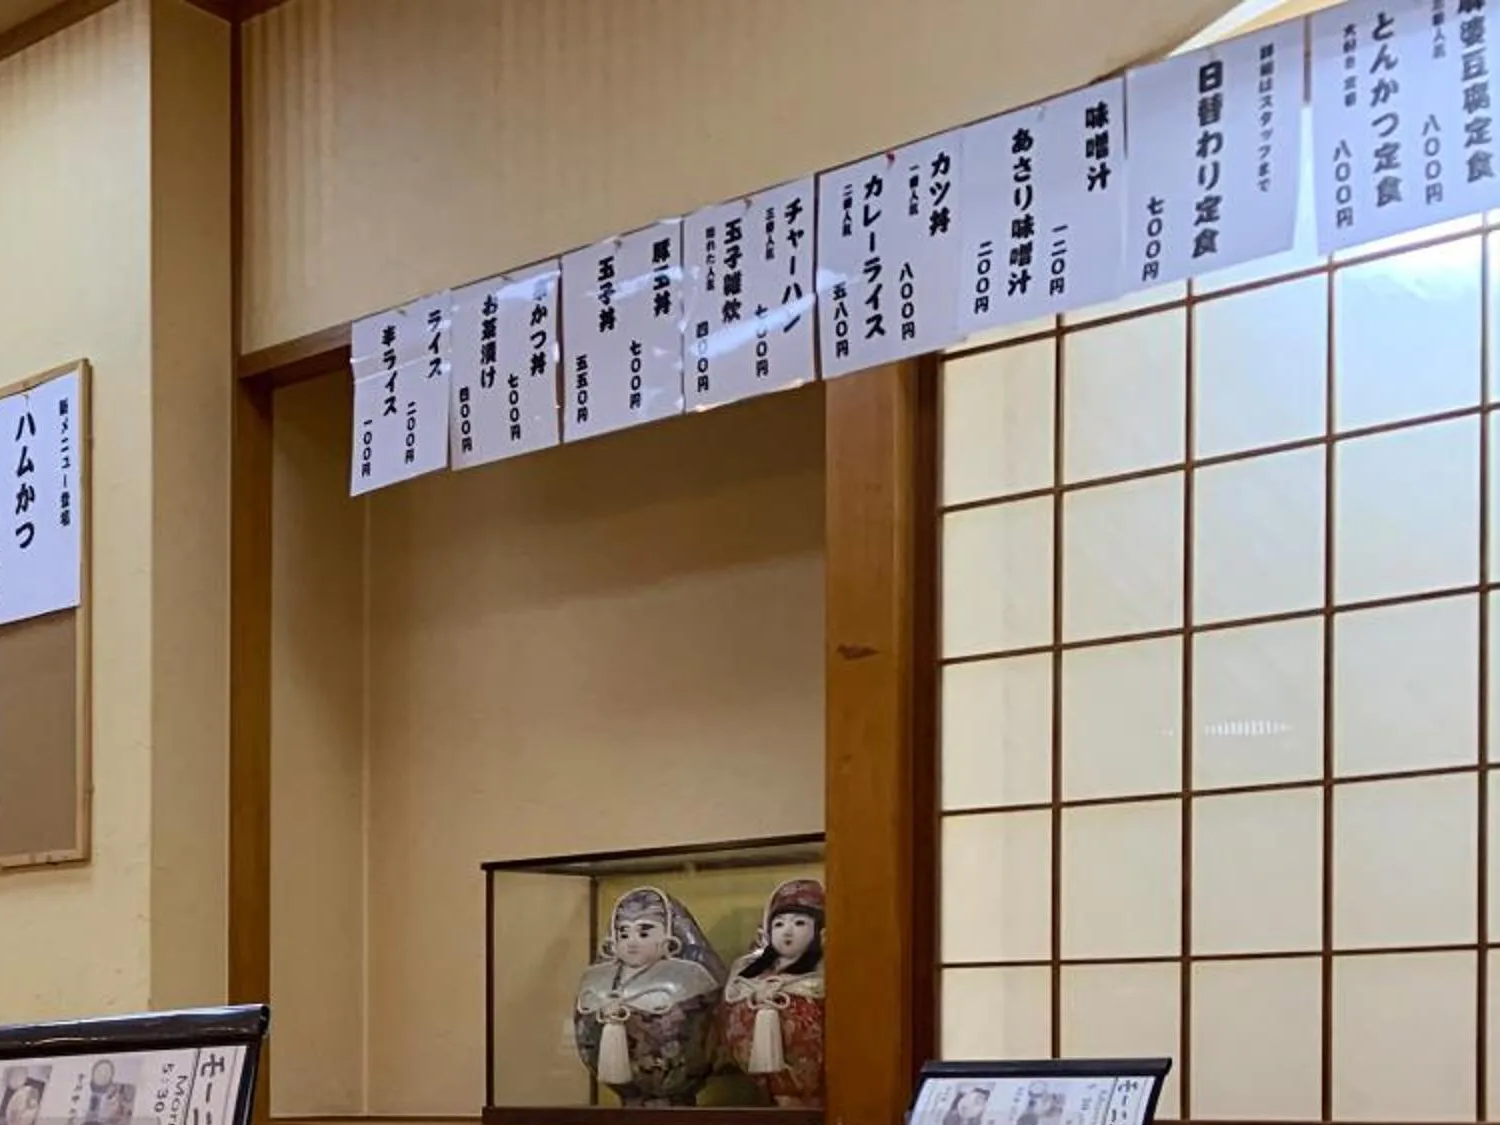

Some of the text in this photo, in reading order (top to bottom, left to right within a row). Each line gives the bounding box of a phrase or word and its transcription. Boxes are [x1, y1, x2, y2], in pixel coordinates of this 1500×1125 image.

[1085, 101, 1111, 191] 味噌汁
[1192, 60, 1223, 258] 日替わり定食
[1368, 11, 1403, 208] とんかつ定食
[929, 152, 950, 236] カツ丼
[1008, 128, 1034, 296] あさり味噌汁
[598, 256, 616, 332] 玉子丼
[722, 218, 742, 322] 玉子雑炊
[782, 198, 804, 333] チャーハン
[863, 175, 885, 339] カレーライス
[382, 326, 397, 416] 半ライス
[428, 310, 441, 378] ライス
[480, 295, 498, 388] お茶漬け
[16, 412, 36, 548] ハムかつ
